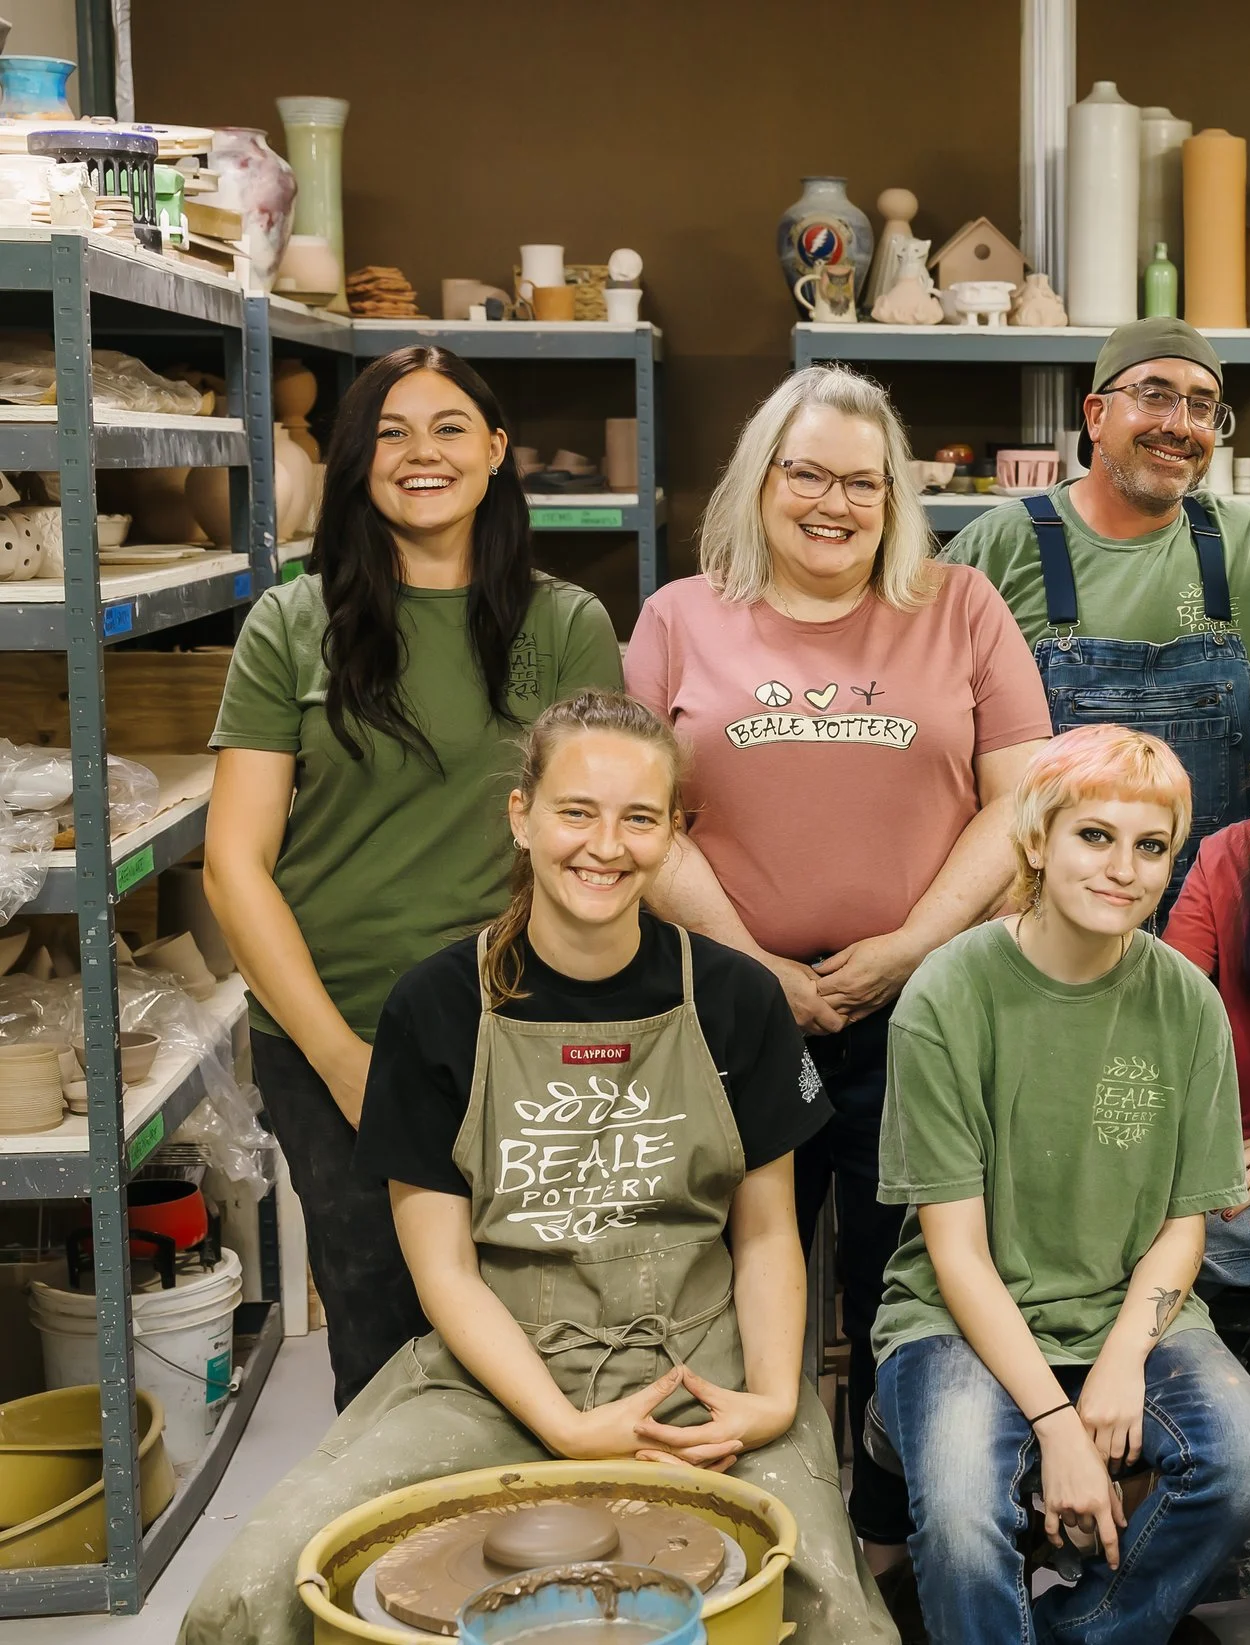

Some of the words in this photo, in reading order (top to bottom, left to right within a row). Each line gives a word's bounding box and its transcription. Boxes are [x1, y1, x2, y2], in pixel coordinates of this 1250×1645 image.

[730, 716, 804, 745] BEALE
[812, 717, 913, 743] POTTERY
[569, 1048, 624, 1060] CLAYPRON
[1092, 1083, 1167, 1110] BEALE
[1095, 1107, 1157, 1122] POTTERY
[494, 1132, 676, 1195] BEALE
[521, 1175, 663, 1208] POTTERY
